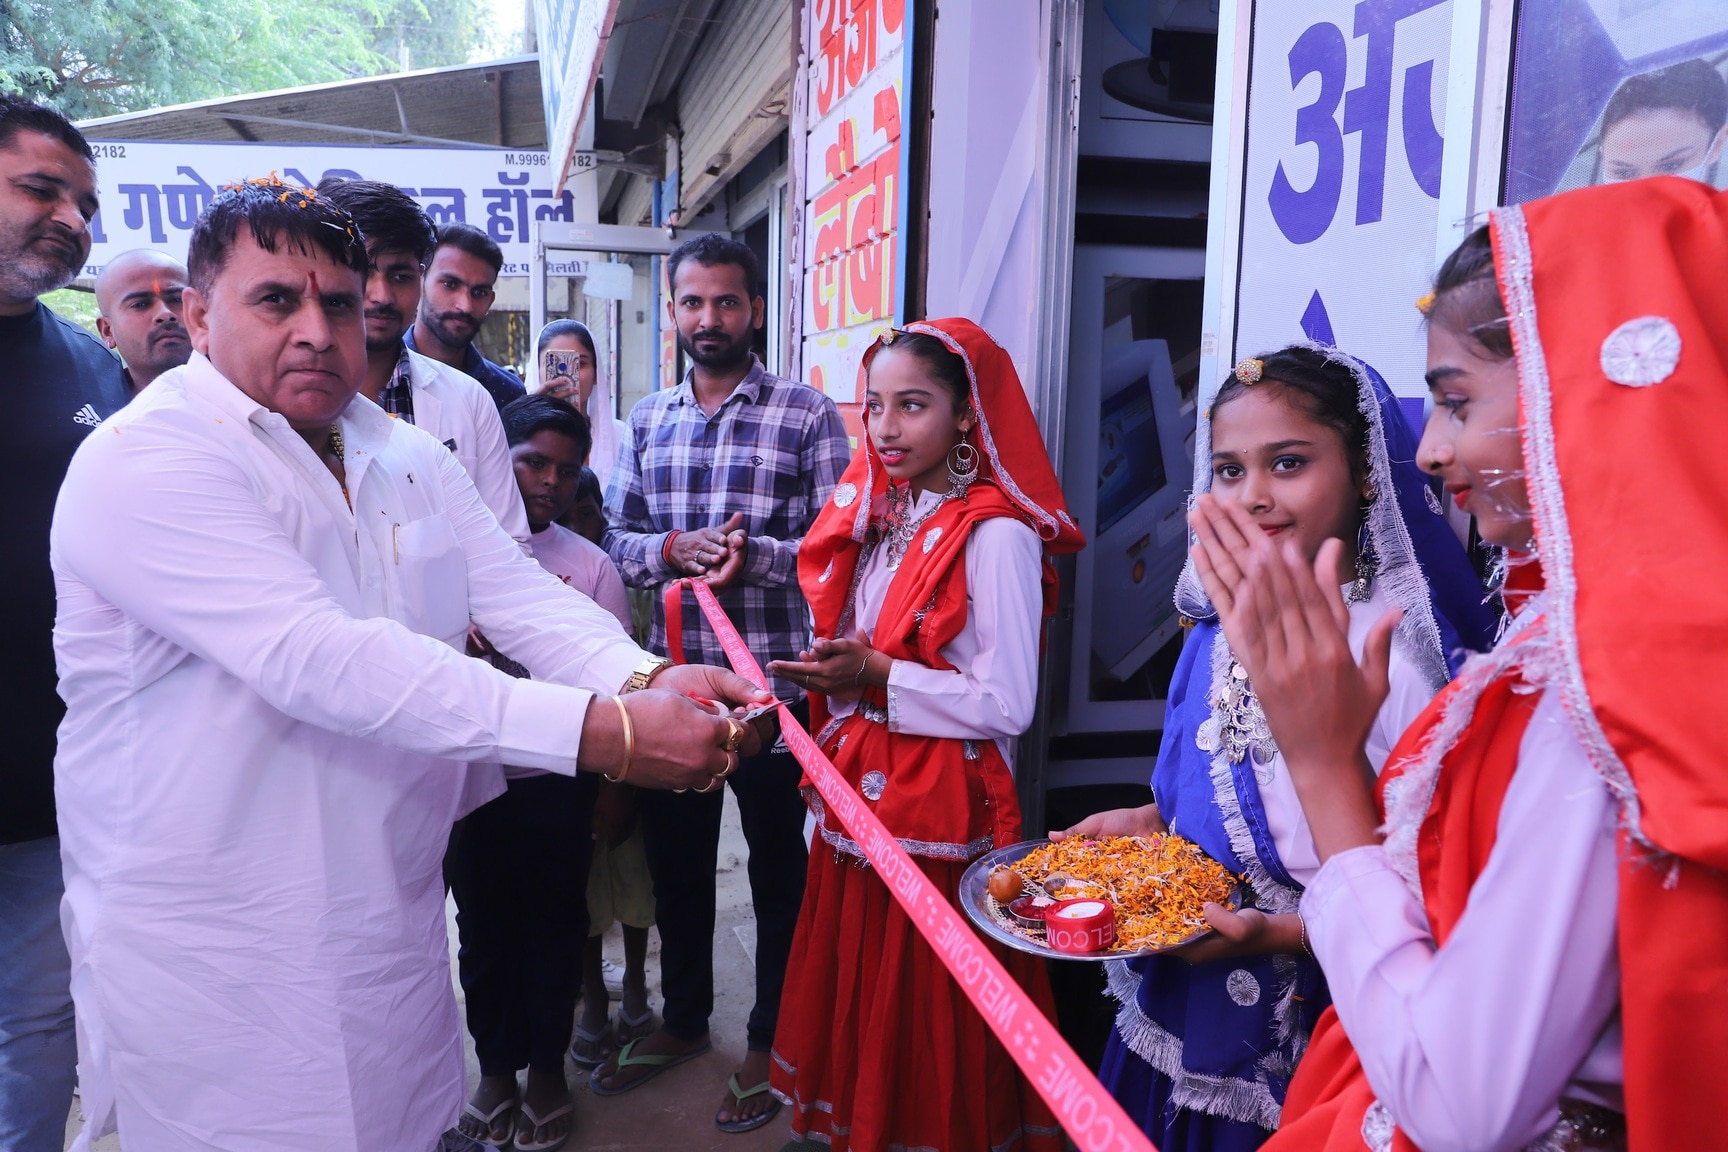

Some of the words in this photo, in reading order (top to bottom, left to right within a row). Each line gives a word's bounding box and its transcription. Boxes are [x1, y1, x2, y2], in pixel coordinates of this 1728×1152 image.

[118, 166, 226, 243] गणे
[771, 746, 790, 754] Reeb
[817, 766, 858, 827] WELCOME
[865, 827, 922, 907] WELCOME
[1046, 922, 1115, 949] ELCOM
[934, 916, 1018, 1033] WELCOME
[1038, 1052, 1134, 1152] COME
